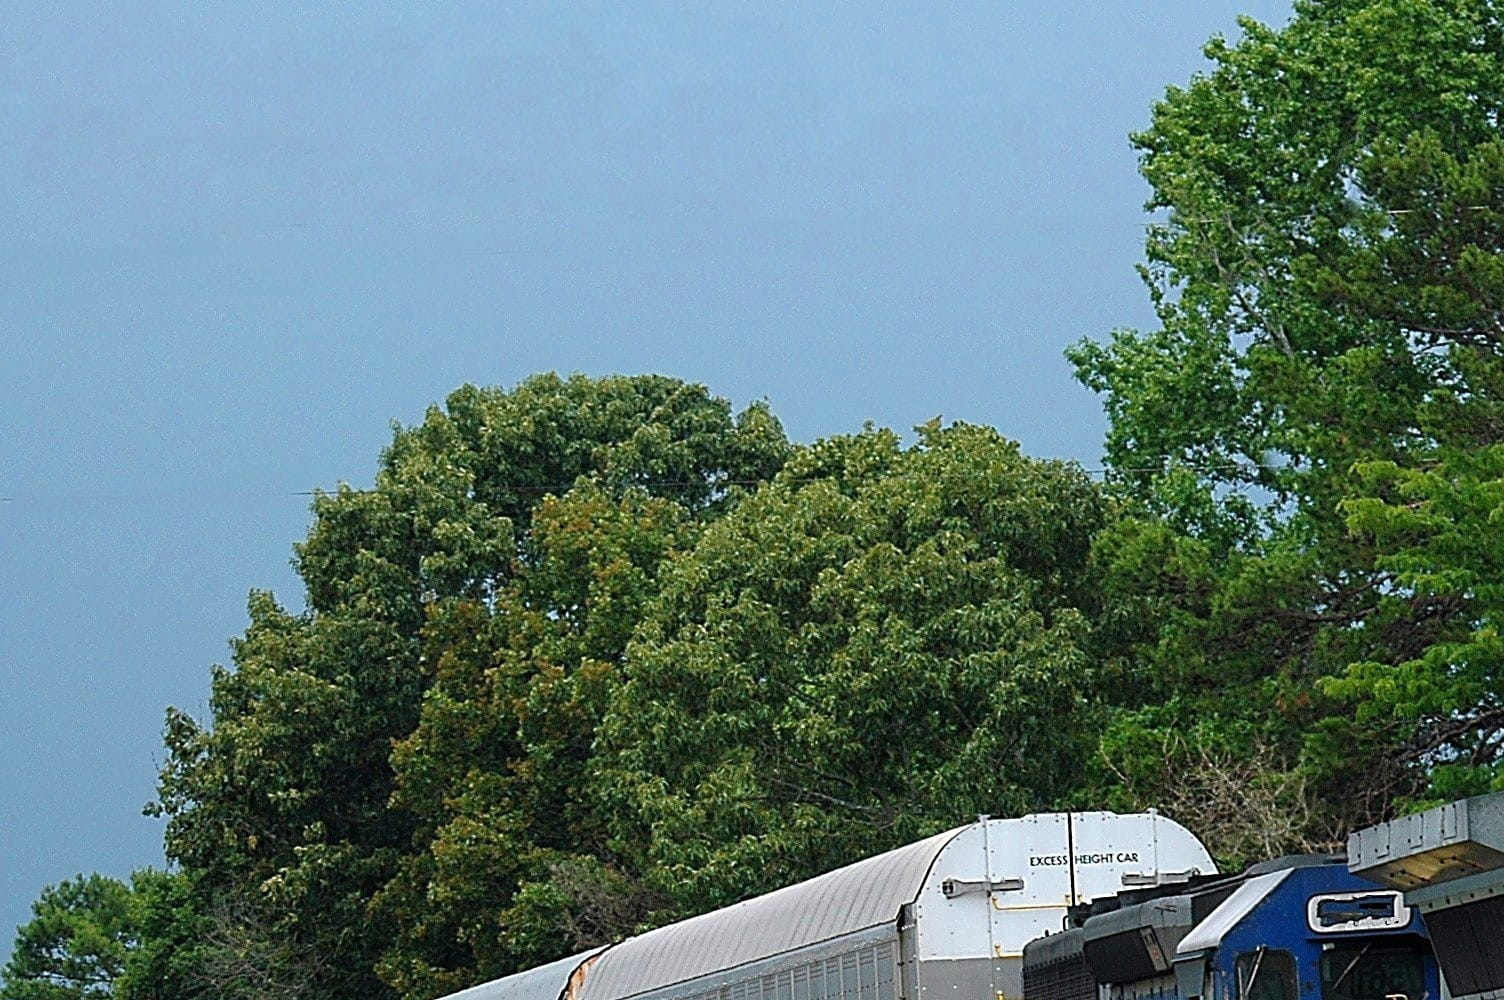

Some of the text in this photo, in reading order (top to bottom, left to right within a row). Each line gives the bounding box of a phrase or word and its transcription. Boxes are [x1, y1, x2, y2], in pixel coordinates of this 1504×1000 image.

[1029, 852, 1139, 867] EXCESS HEIGHT CAR
